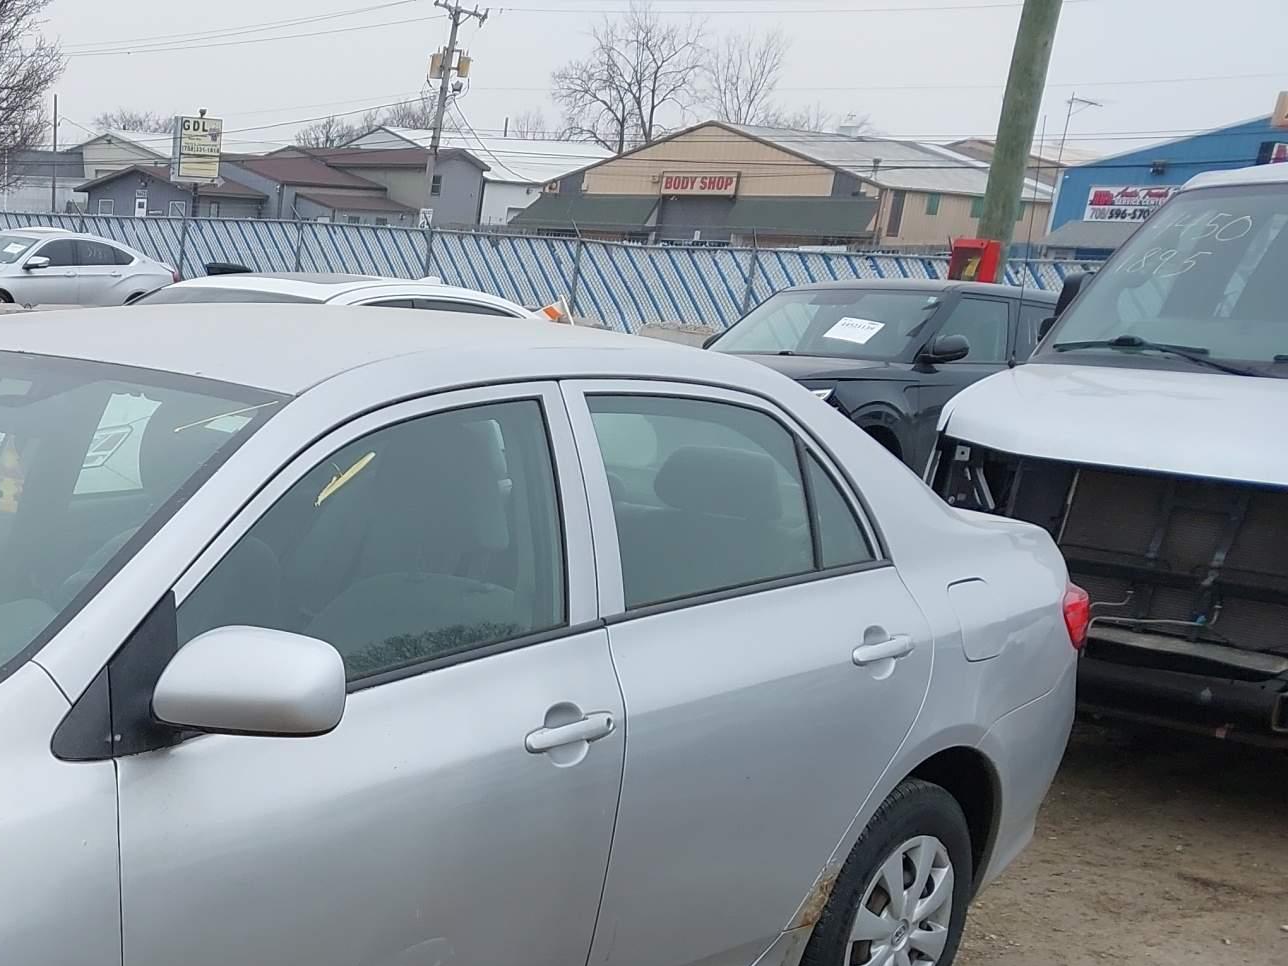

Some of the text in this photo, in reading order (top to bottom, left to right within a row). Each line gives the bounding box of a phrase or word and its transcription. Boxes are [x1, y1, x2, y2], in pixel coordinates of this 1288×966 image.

[183, 120, 208, 132] GDL
[664, 176, 734, 190] BODY SHOP
